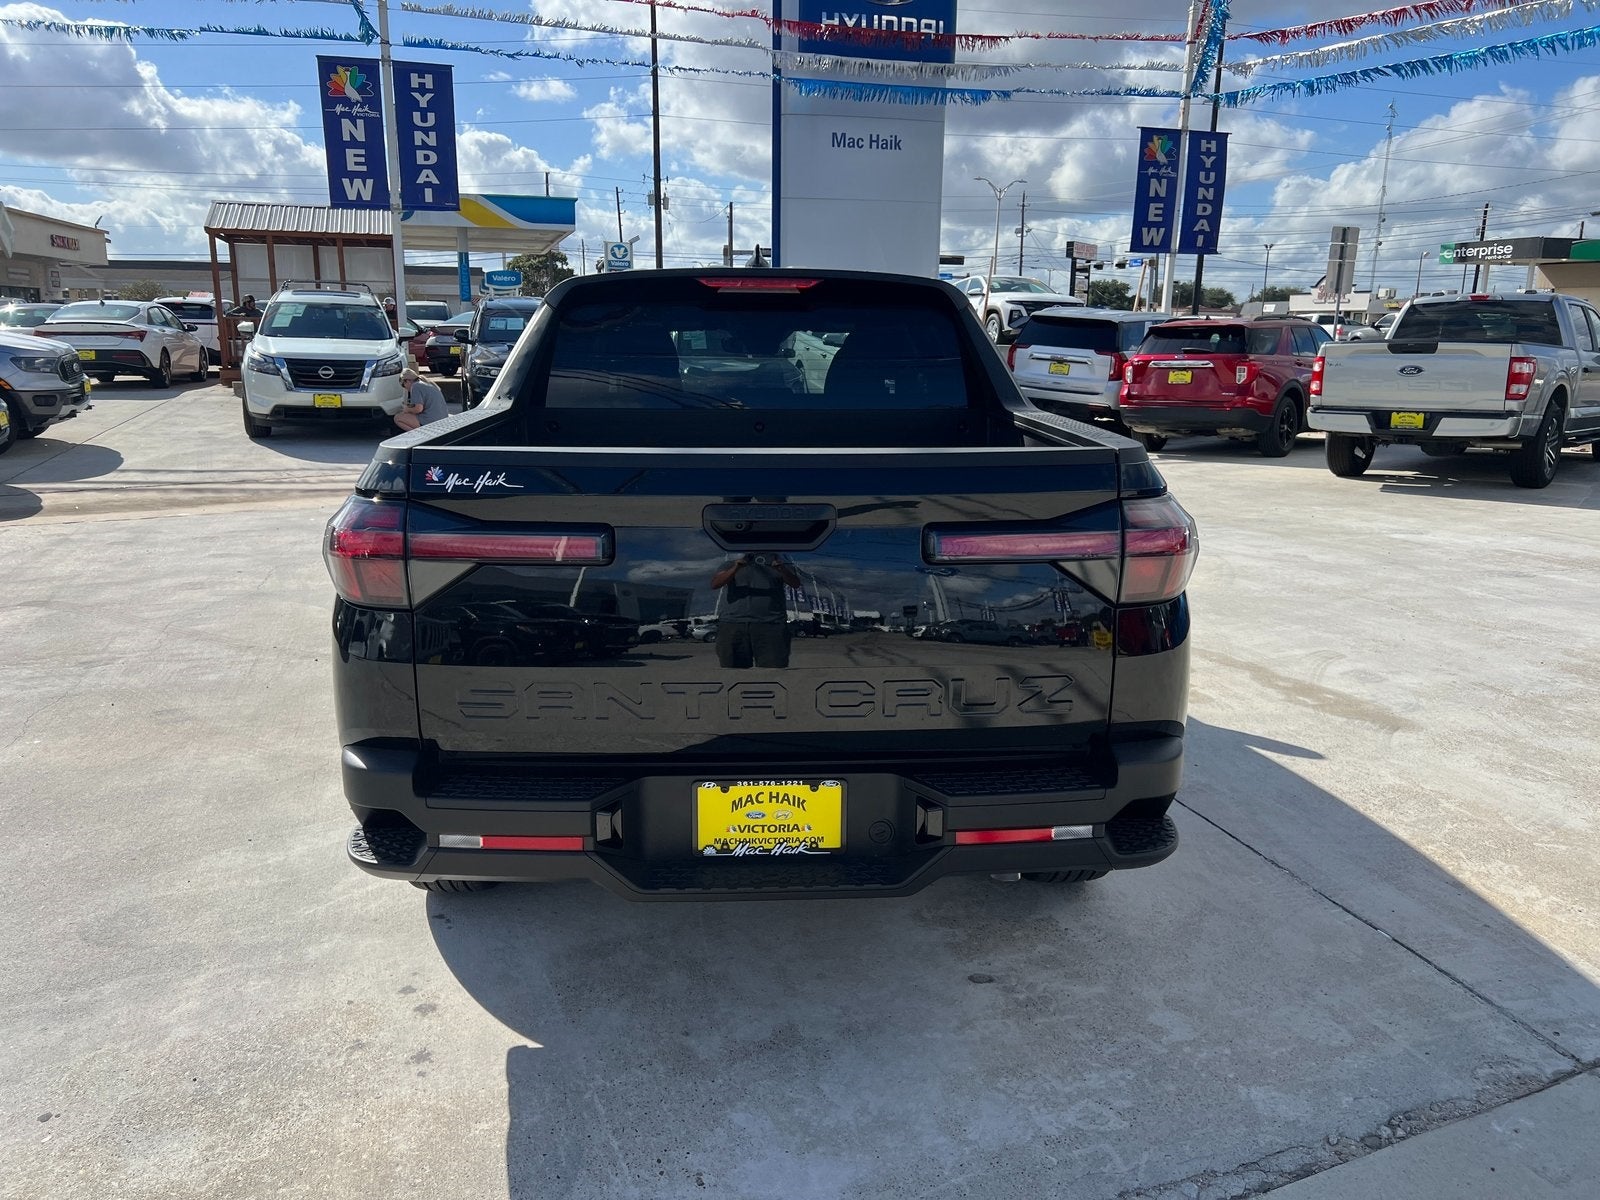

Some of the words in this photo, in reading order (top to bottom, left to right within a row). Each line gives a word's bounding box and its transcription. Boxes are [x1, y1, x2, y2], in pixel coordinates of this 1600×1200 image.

[331, 103, 351, 116] Mac
[351, 103, 374, 116] Haik
[410, 72, 440, 203] HYUNDAI
[831, 132, 864, 149] Mac
[869, 133, 902, 150] Haik
[341, 118, 374, 201] NEW
[1193, 140, 1217, 247] HYUNDAI
[1142, 178, 1167, 246] NEW
[1440, 243, 1513, 258] enterprise
[492, 274, 516, 282] Valero
[440, 472, 473, 493] Mac
[473, 470, 513, 493] Haik
[456, 681, 787, 720] SANTA
[814, 674, 1074, 718] CRUZ
[731, 792, 765, 813] MAC
[768, 791, 807, 812] HAIK
[748, 811, 764, 819] Ford
[737, 824, 801, 833] VICTORIA
[731, 841, 769, 857] Mac
[770, 841, 815, 856] Haik
